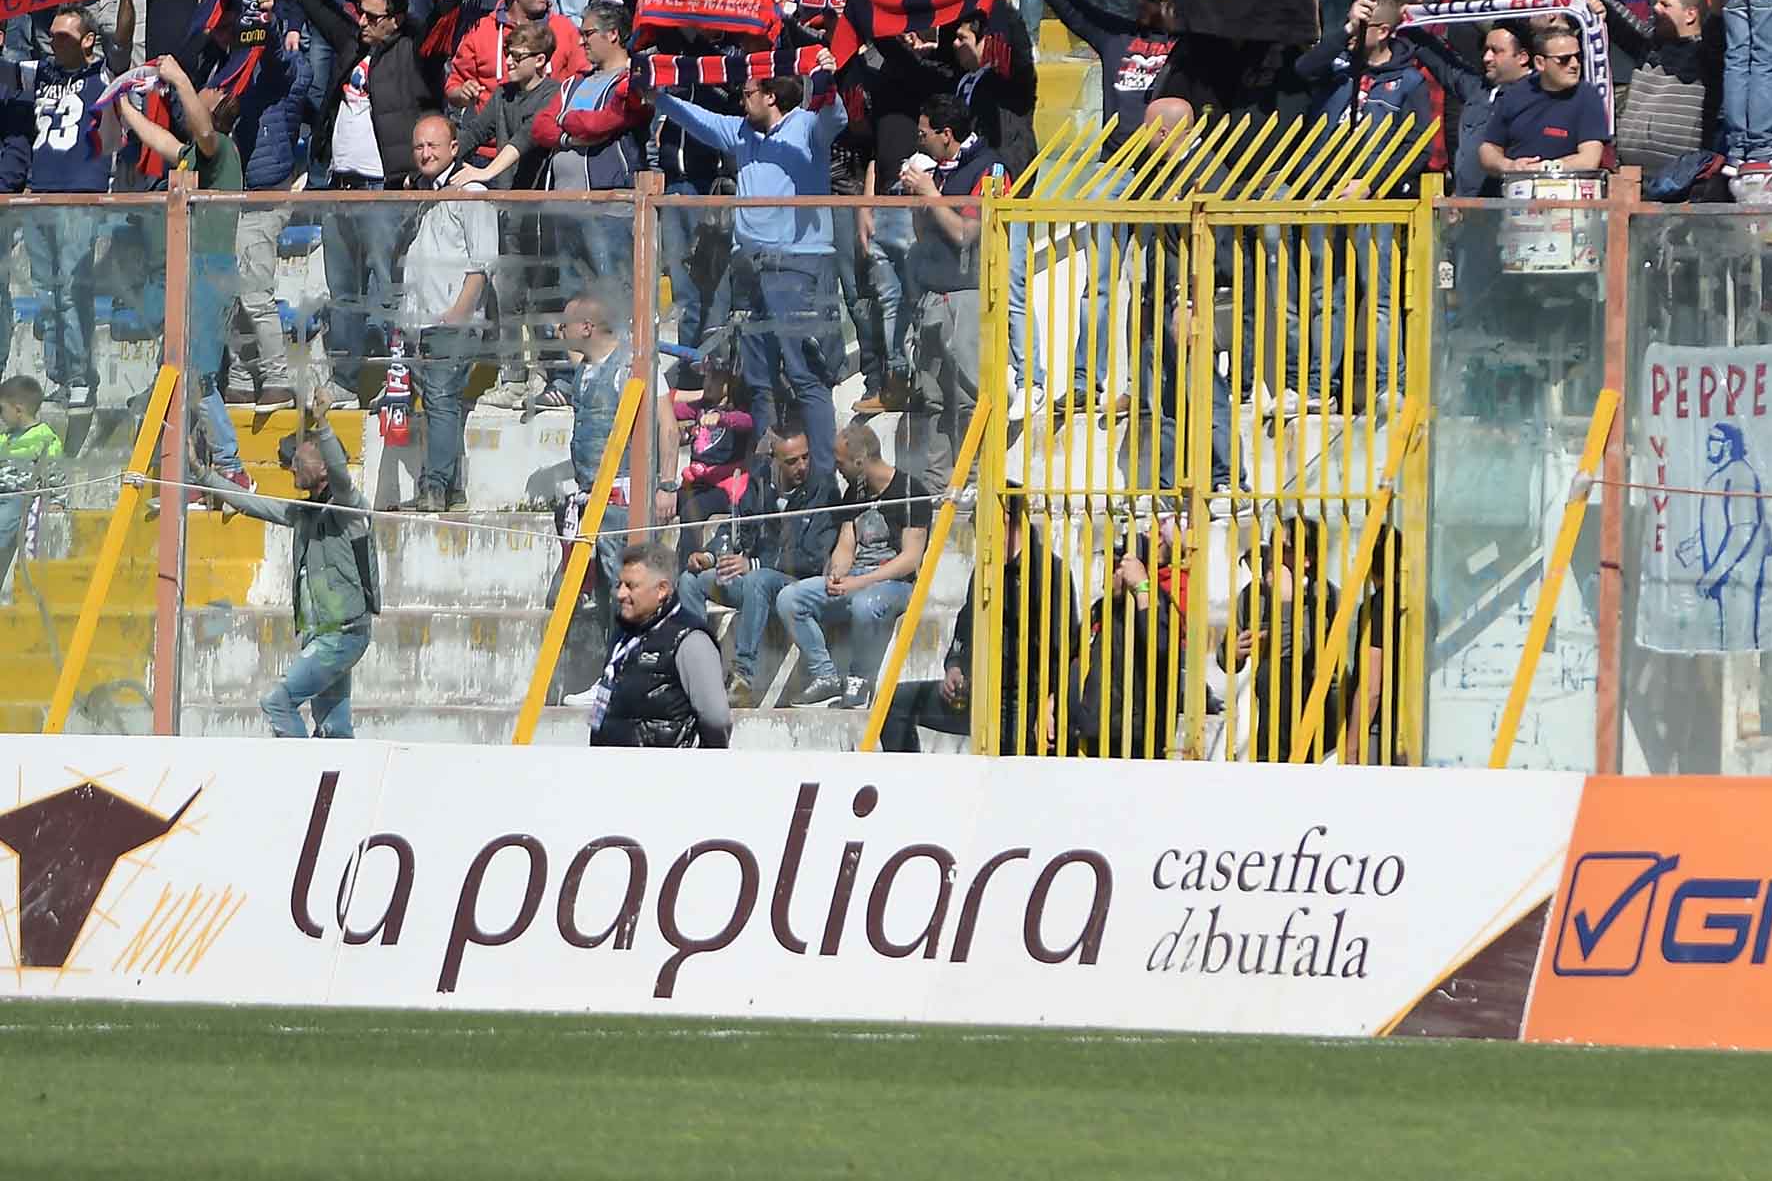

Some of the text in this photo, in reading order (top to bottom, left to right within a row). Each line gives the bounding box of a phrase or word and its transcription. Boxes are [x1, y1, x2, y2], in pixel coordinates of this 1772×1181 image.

[1651, 361, 1769, 419] PEPPE
[290, 769, 1115, 1001] la pagliara
[1152, 825, 1406, 899] caseificio
